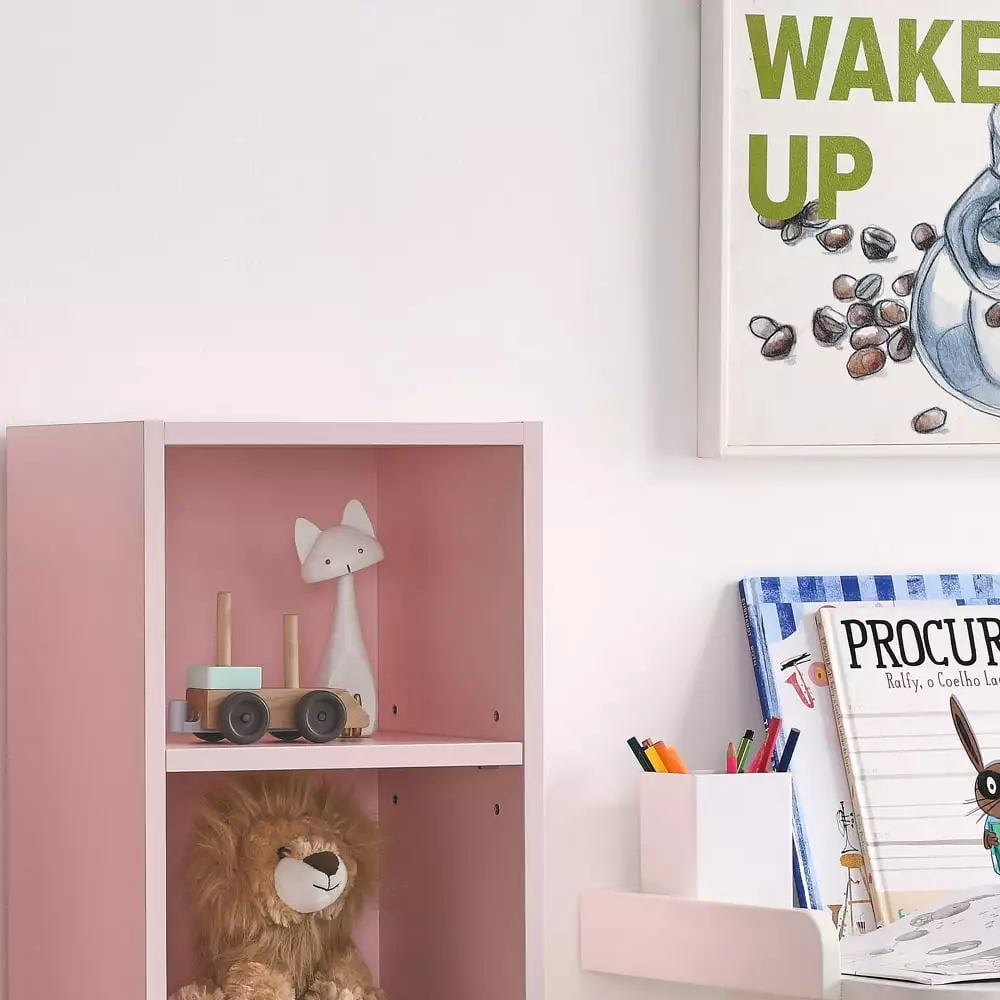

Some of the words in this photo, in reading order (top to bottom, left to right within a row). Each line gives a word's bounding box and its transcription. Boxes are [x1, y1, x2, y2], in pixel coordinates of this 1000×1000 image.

[745, 14, 1000, 104] WAKE
[748, 134, 874, 220] UP
[885, 671, 923, 693] Ralfy,
[927, 677, 934, 688] o
[937, 670, 981, 688] Coelho
